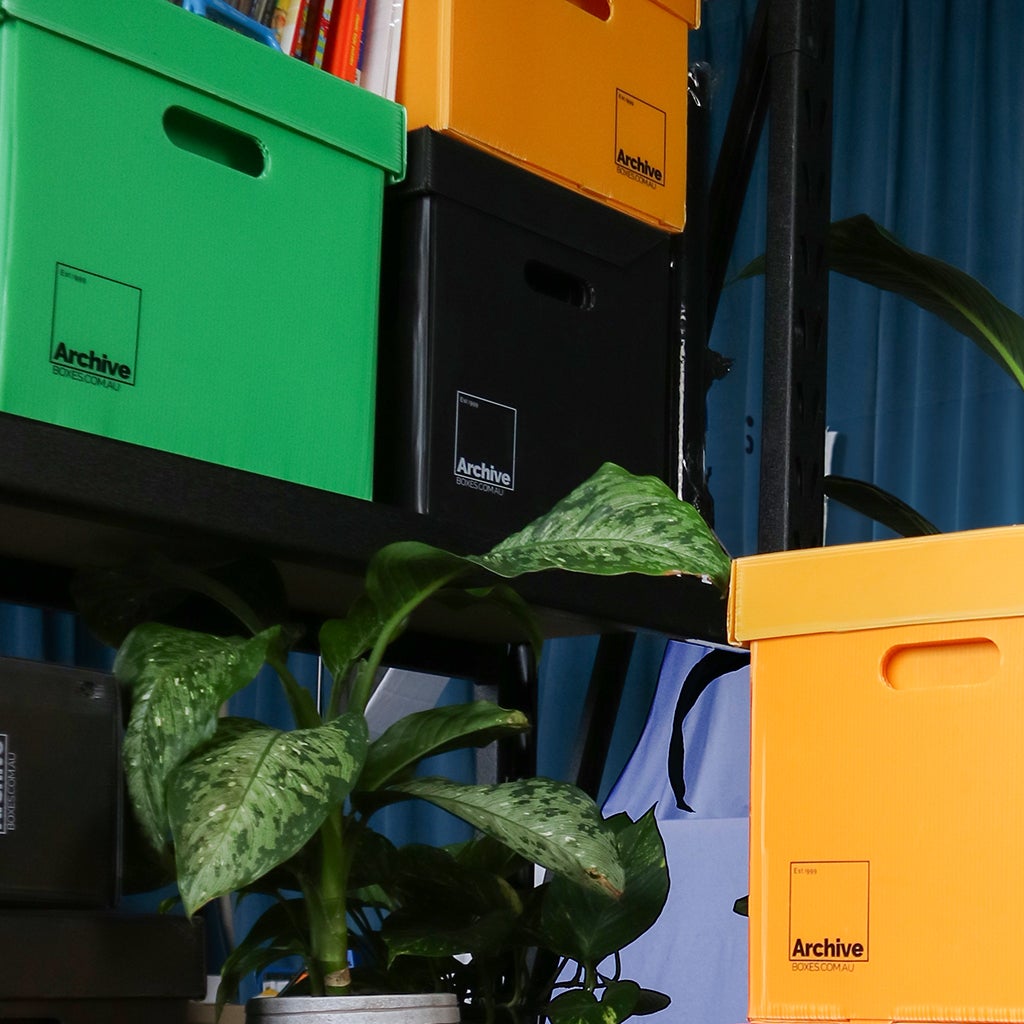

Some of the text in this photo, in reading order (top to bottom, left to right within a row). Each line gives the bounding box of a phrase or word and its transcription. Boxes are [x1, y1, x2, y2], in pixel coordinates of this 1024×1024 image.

[617, 148, 662, 181] Archive
[54, 341, 131, 379] Archive
[457, 457, 511, 486] Archive
[792, 938, 864, 957] Archive
